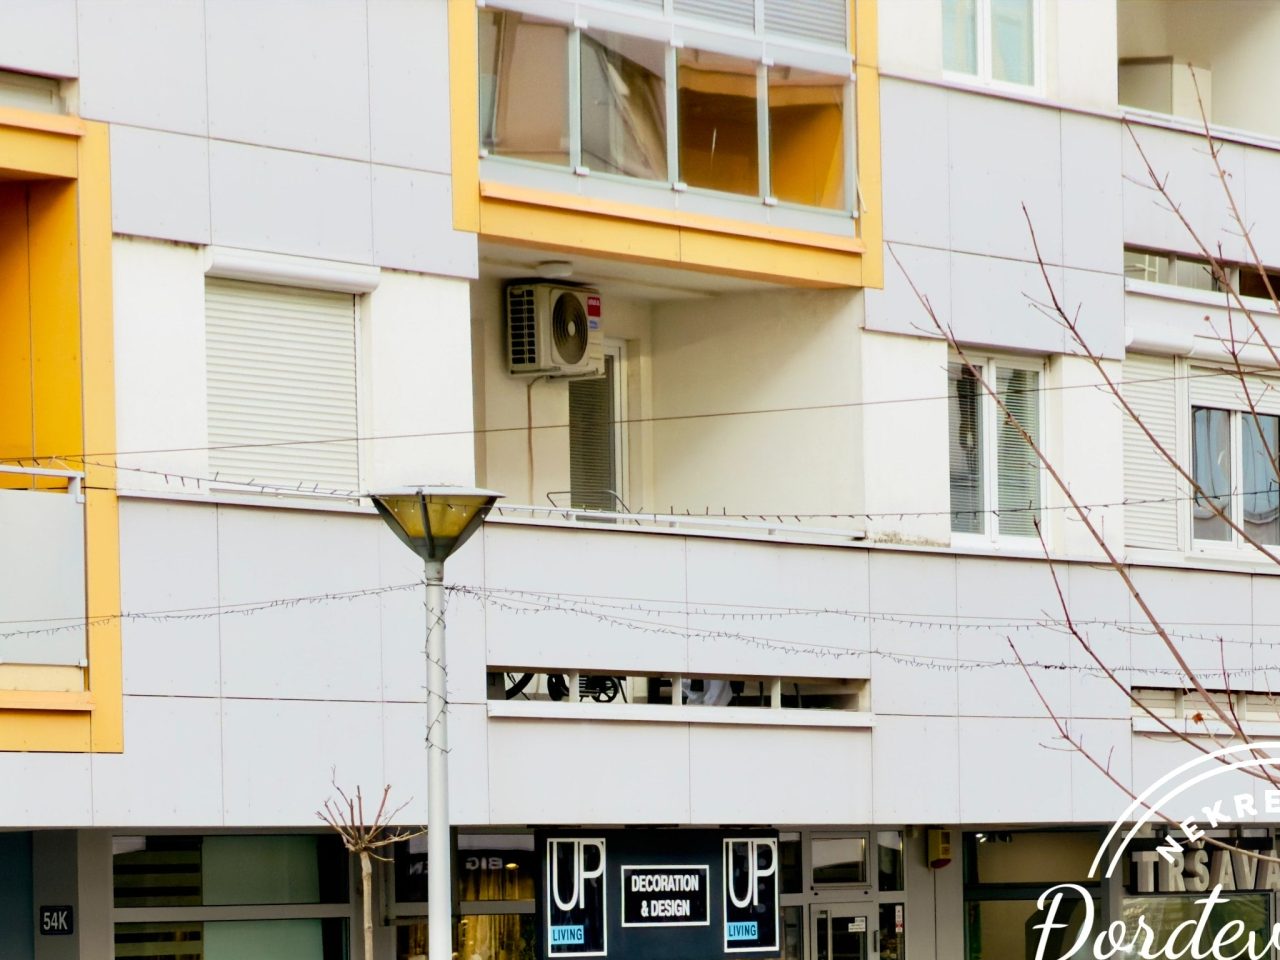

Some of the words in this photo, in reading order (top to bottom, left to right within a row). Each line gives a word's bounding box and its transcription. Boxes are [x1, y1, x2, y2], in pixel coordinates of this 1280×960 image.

[552, 839, 605, 912] UP
[631, 874, 699, 892] DECORATION
[728, 839, 777, 909] UP
[640, 900, 650, 917] &
[650, 899, 691, 917] DESIGN
[552, 927, 583, 942] LIVING
[728, 923, 757, 938] LIVING
